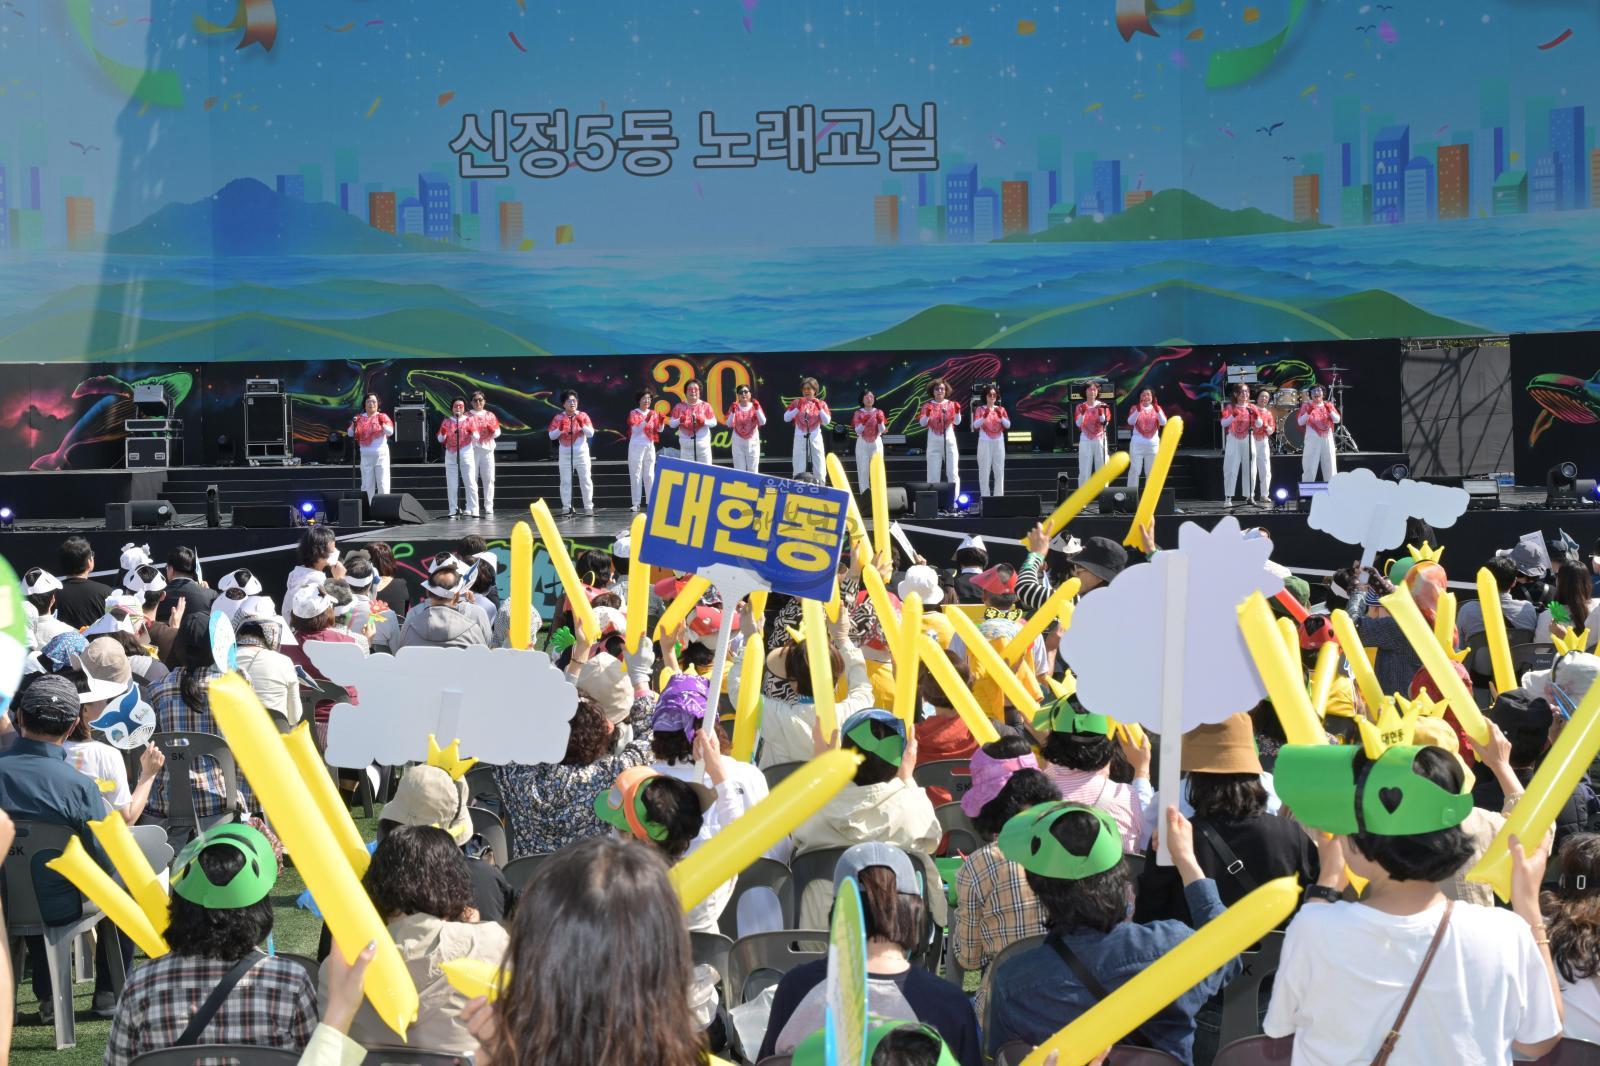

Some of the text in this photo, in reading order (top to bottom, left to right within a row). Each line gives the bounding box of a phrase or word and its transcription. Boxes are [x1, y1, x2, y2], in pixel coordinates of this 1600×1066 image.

[449, 102, 939, 178] 신정5동 노래교실
[650, 468, 841, 572] 대현동
[171, 752, 185, 761] SK
[1380, 729, 1404, 745] 대현동
